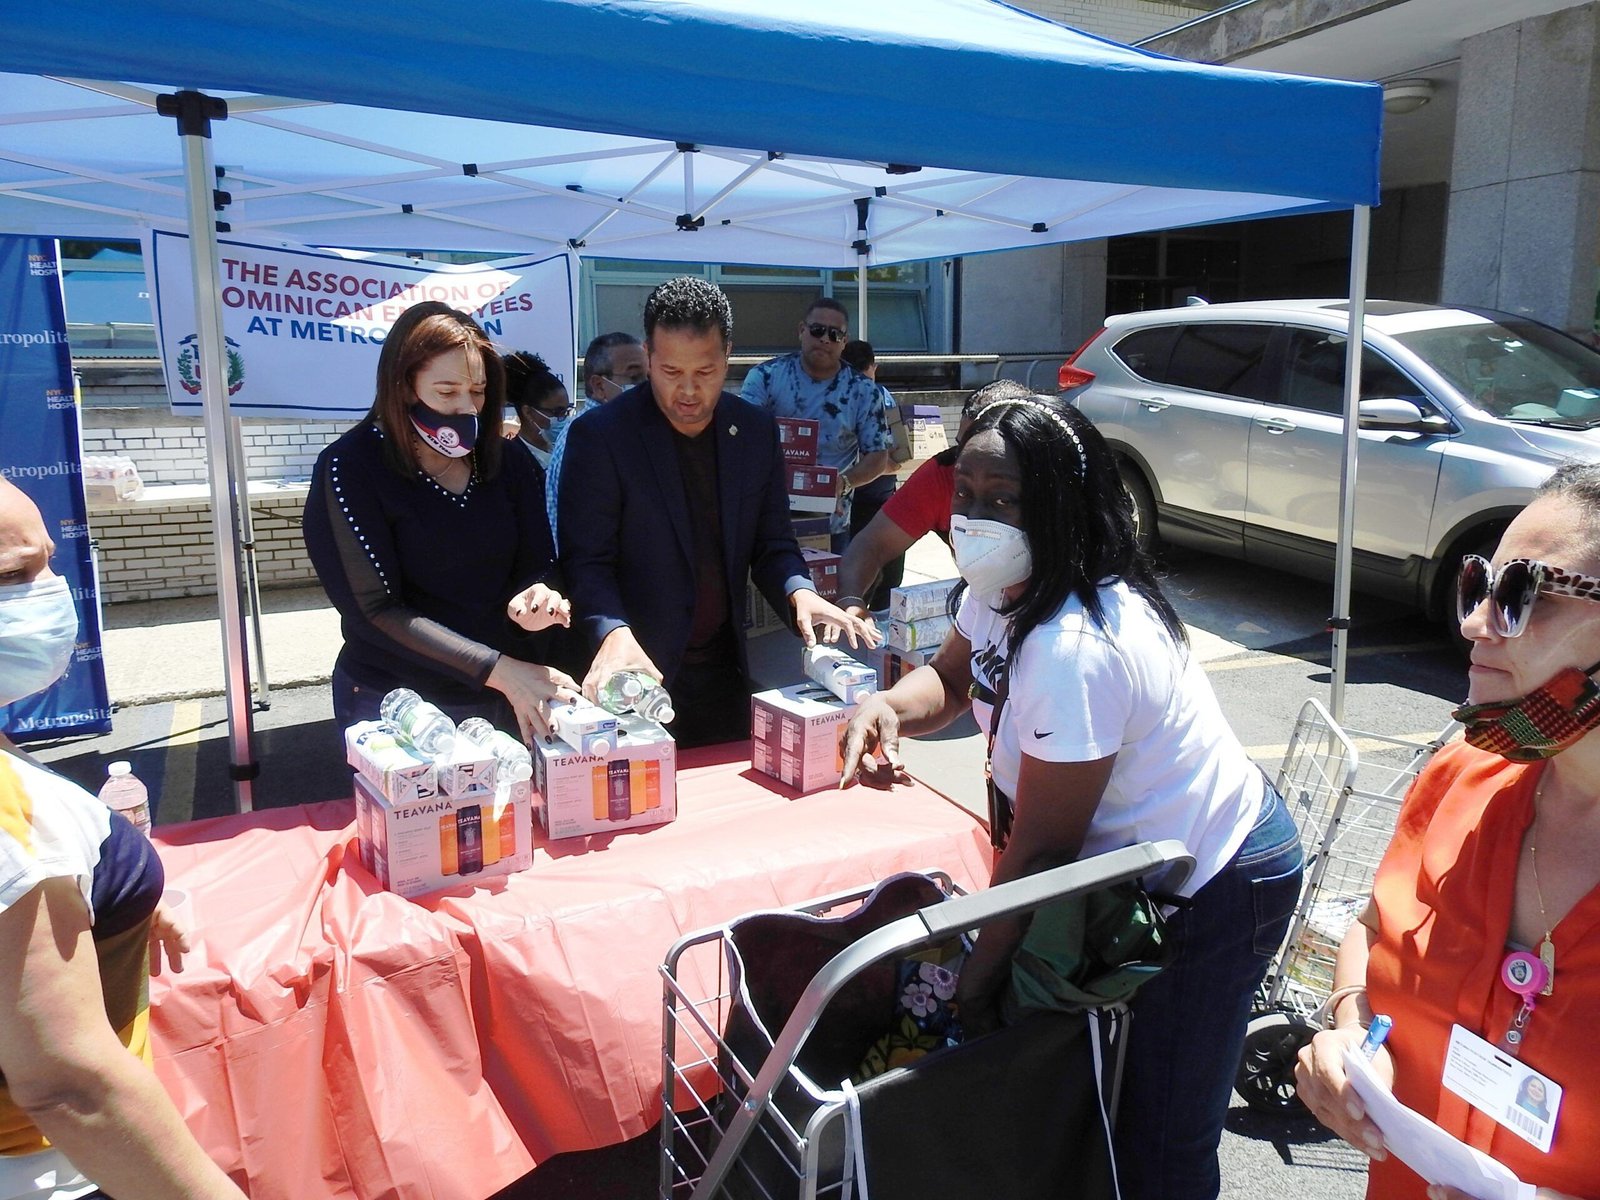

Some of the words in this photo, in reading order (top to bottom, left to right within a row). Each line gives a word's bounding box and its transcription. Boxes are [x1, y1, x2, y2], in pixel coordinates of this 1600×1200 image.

[222, 258, 279, 286] THE
[285, 268, 469, 301] ASSOCIATION
[476, 280, 511, 298] OF
[221, 286, 374, 321] OMINICAN
[247, 315, 283, 337] AT
[810, 713, 846, 727] TEAVANA
[394, 801, 453, 820] TEAVANA
